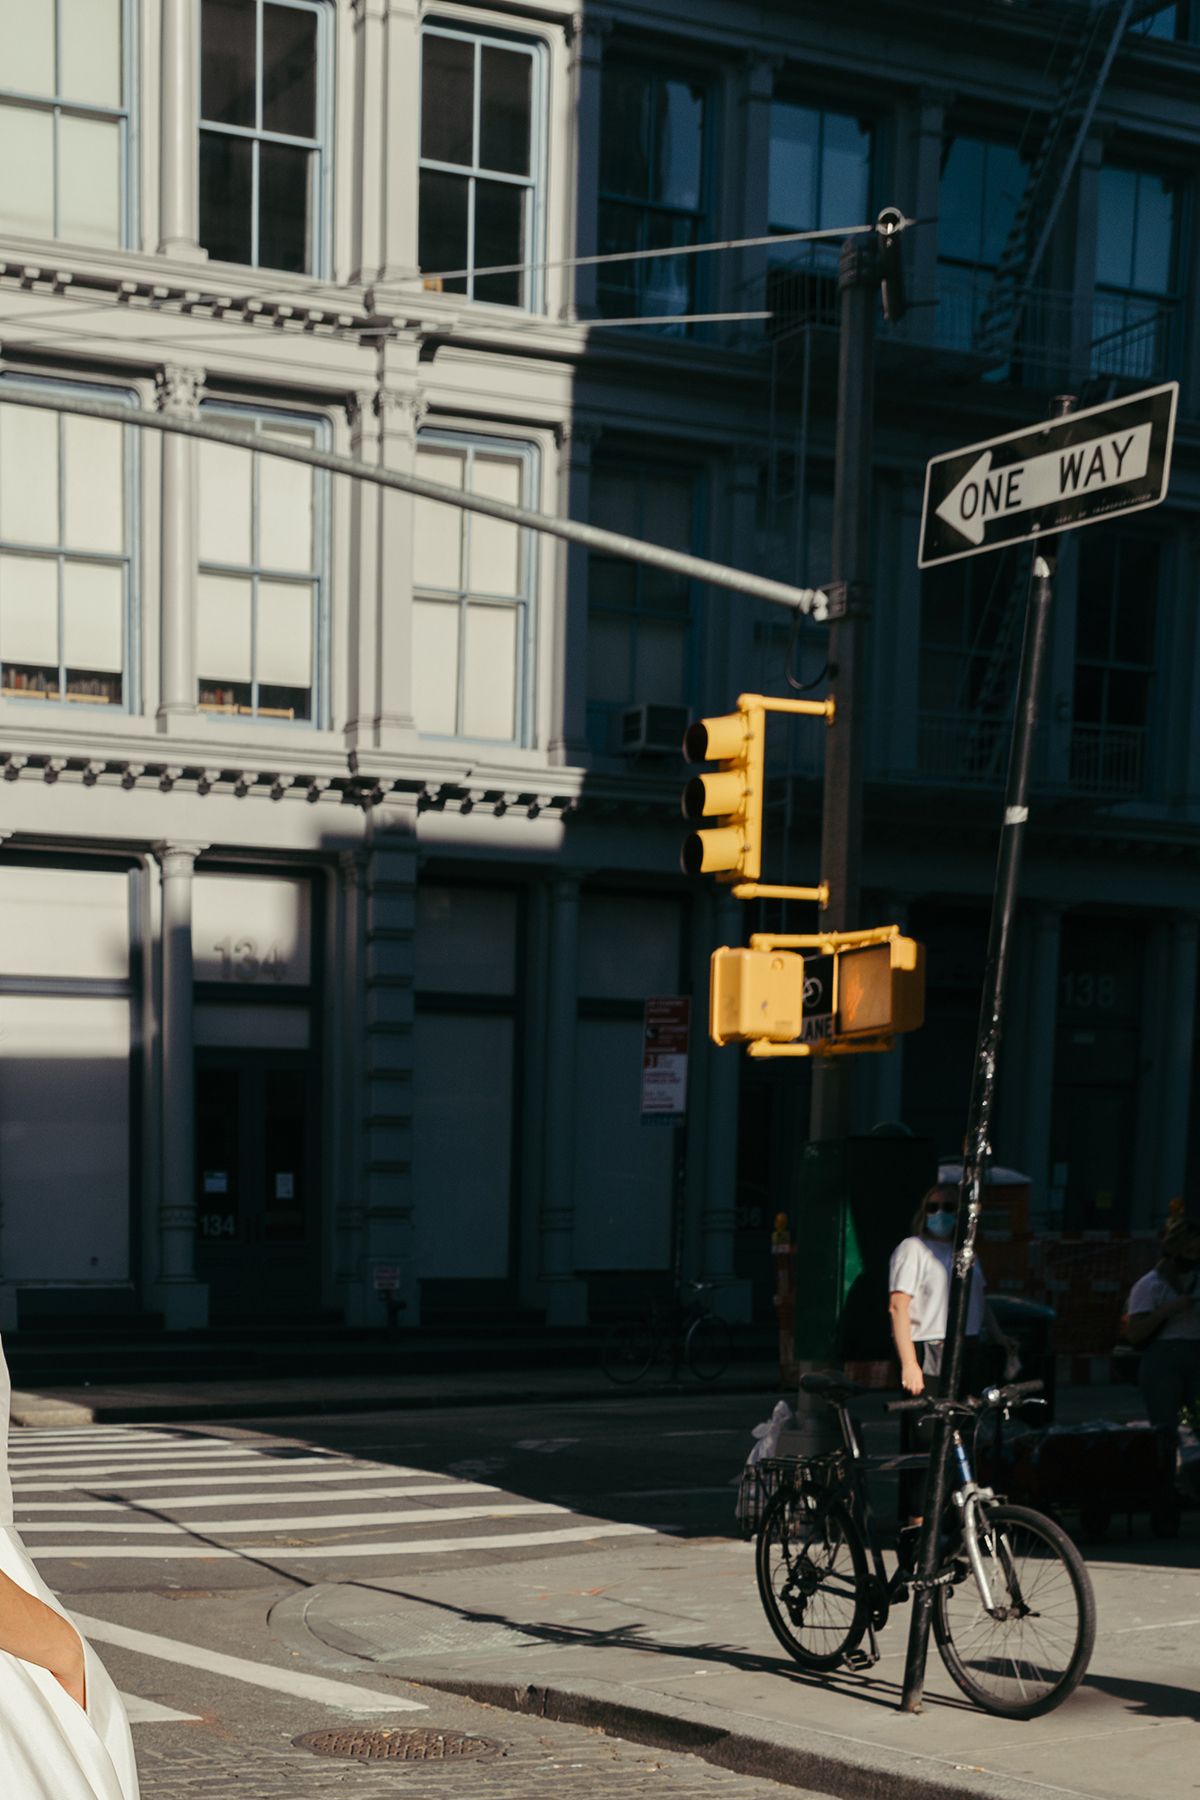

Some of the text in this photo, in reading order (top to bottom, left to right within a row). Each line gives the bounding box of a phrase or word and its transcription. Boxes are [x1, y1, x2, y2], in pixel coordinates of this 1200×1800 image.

[960, 434, 1135, 520] ONE WAY
[213, 936, 287, 981] 134
[201, 1213, 236, 1237] 134
